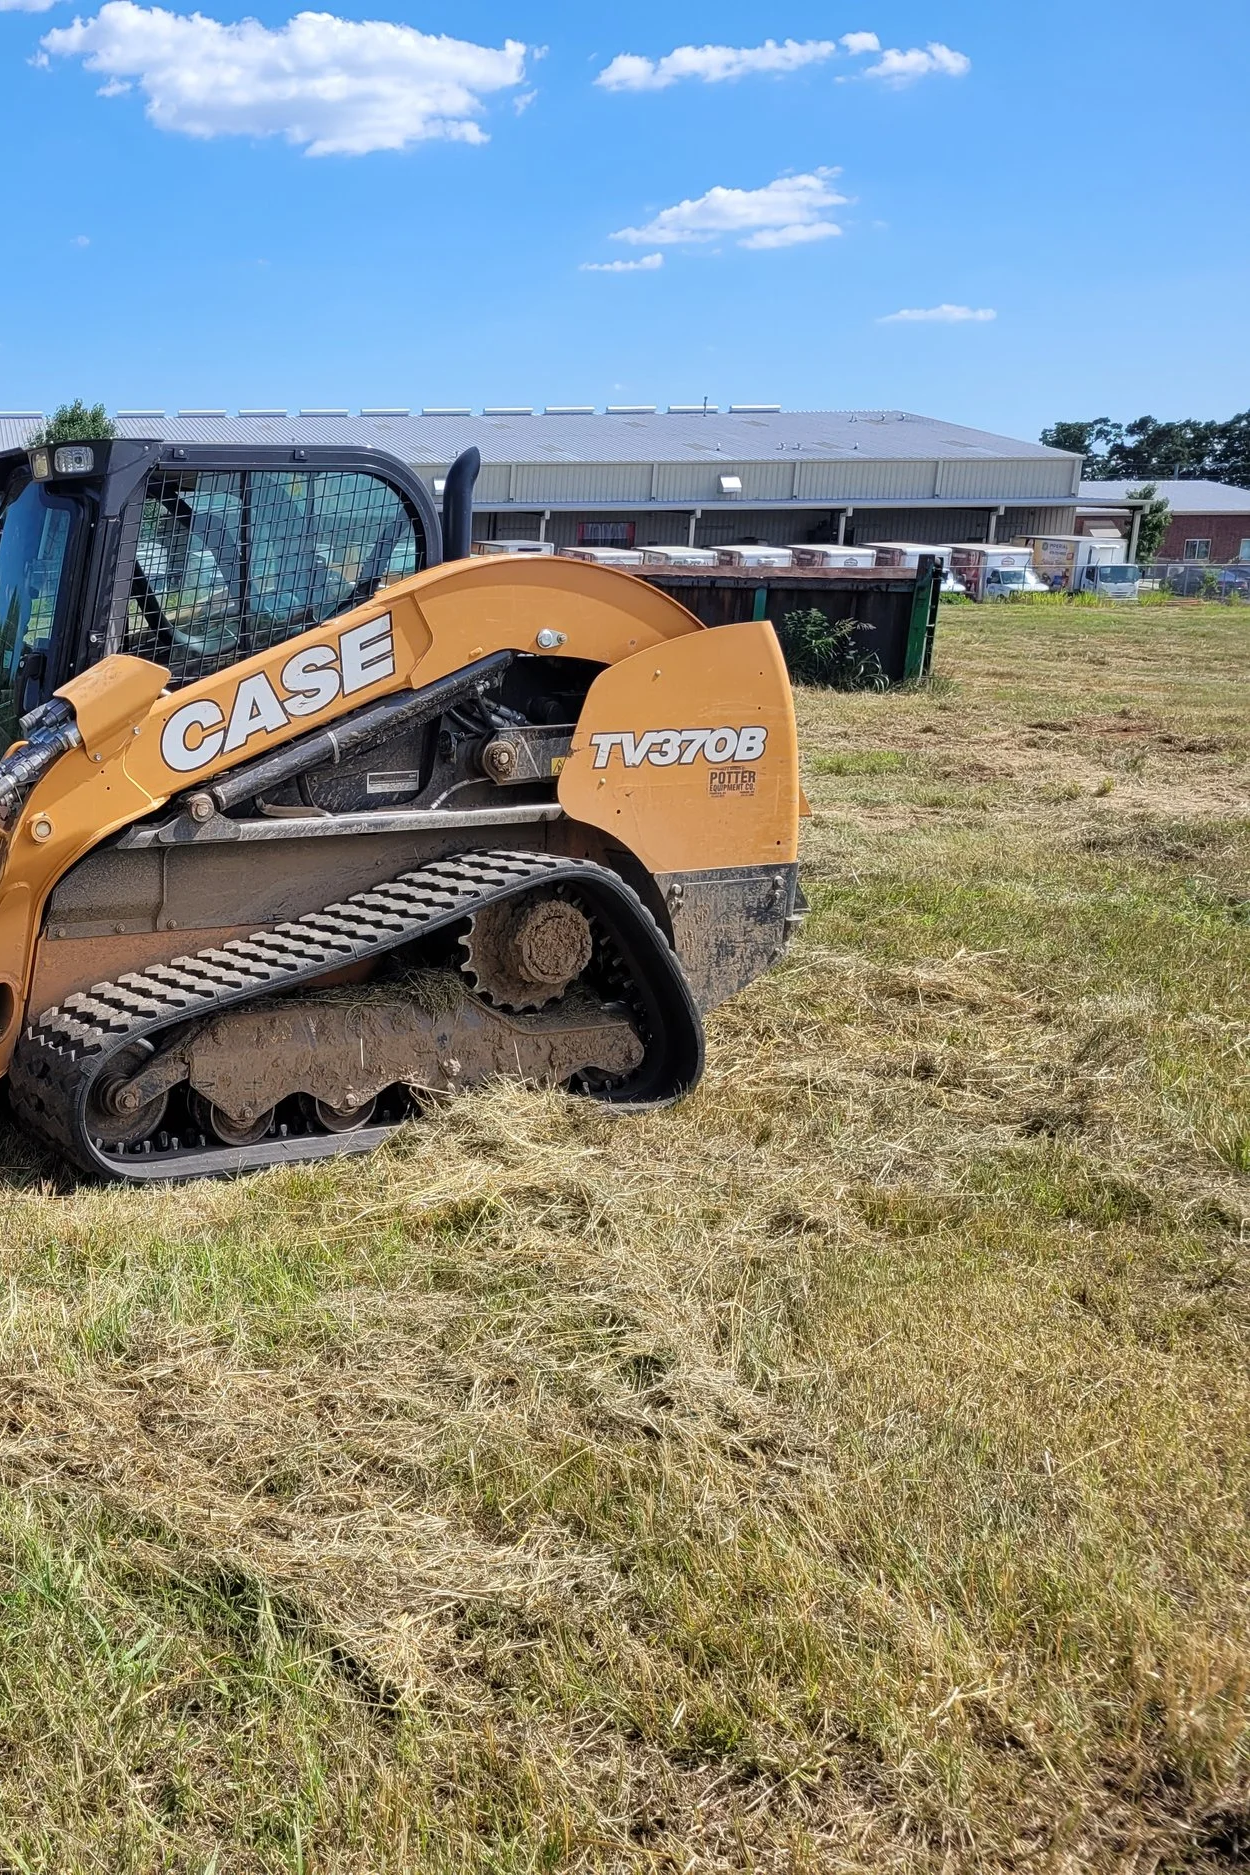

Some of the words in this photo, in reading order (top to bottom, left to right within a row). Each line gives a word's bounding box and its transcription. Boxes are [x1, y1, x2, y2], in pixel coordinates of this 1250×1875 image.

[160, 610, 395, 773] CASE
[589, 726, 768, 769] TV370B
[710, 770, 756, 785] POTTER
[710, 783, 744, 792] EQUIPMENT
[745, 783, 755, 791] CO.
